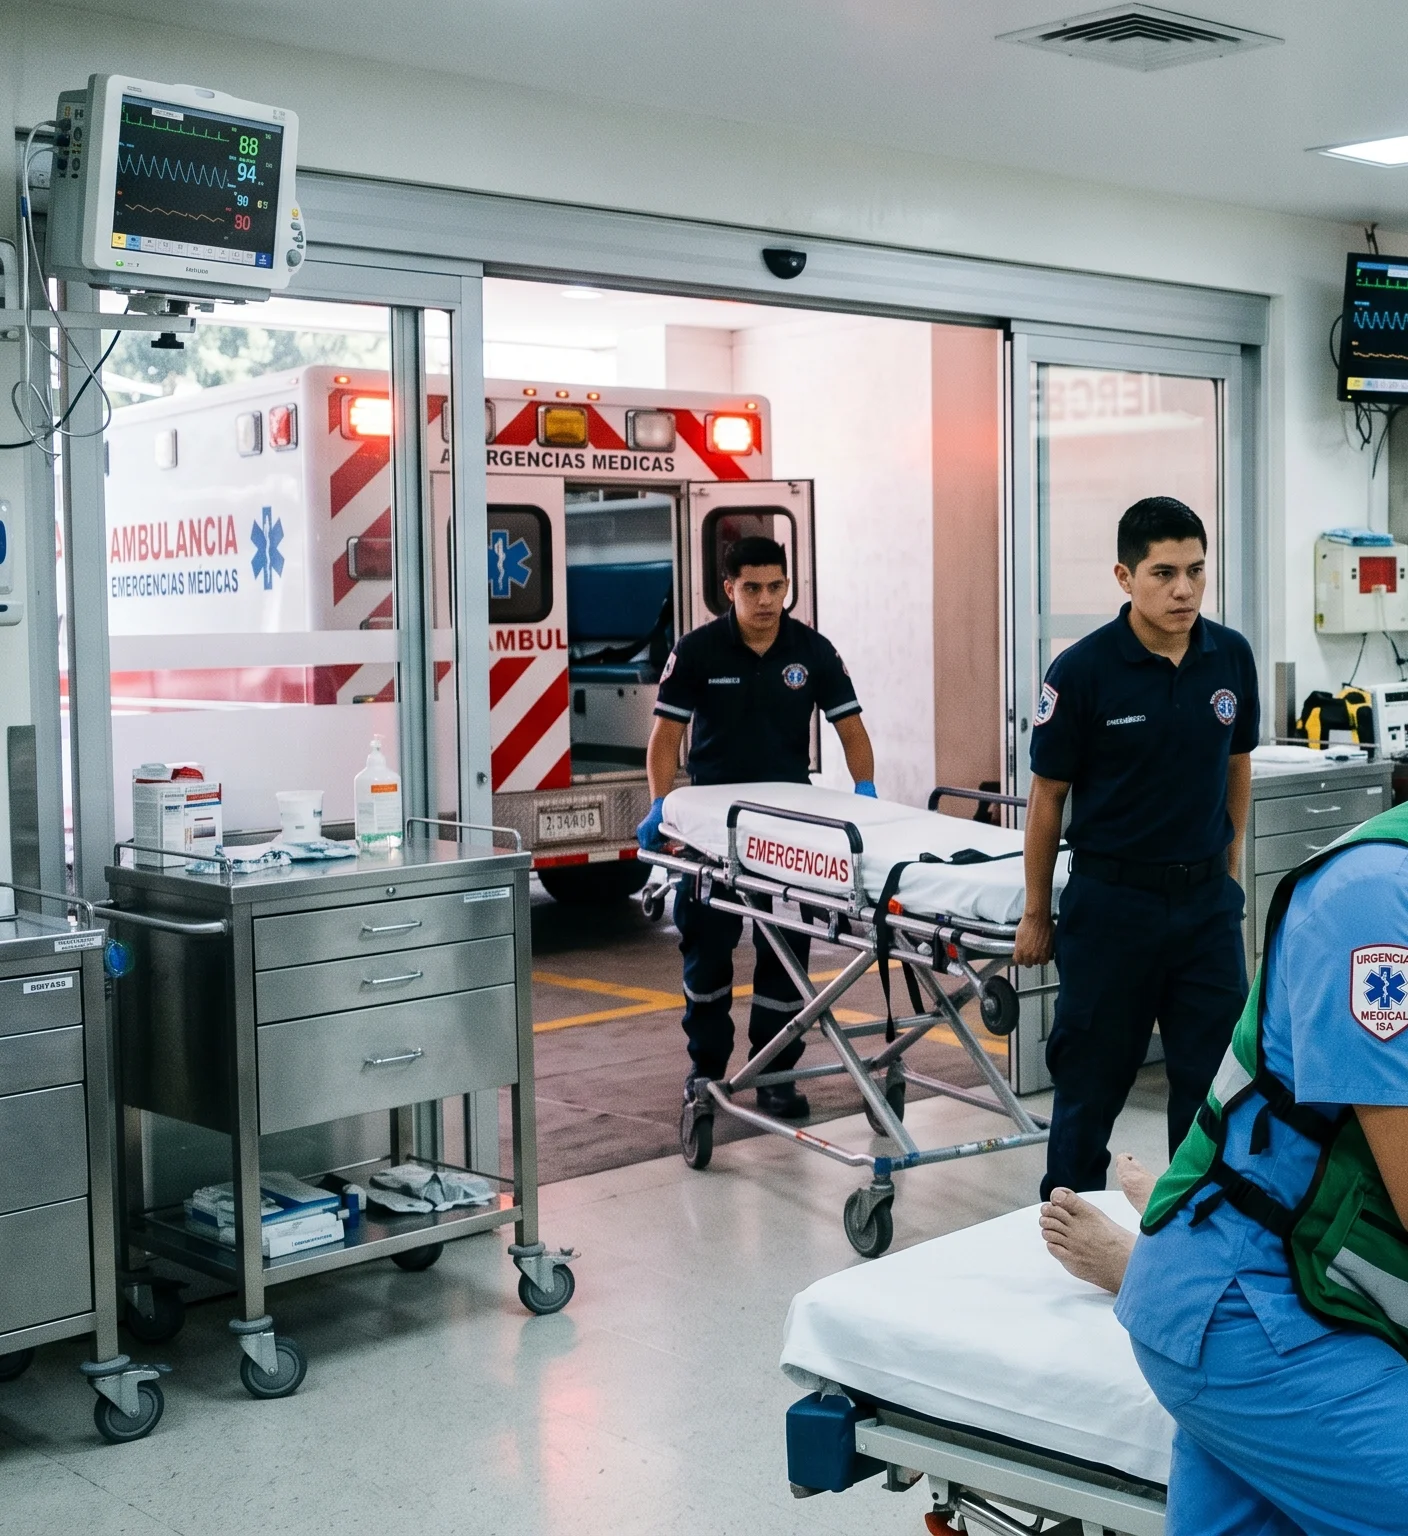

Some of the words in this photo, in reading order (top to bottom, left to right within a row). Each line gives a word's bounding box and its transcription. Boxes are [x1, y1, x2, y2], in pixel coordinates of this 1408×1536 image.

[239, 135, 259, 156] 88
[237, 163, 257, 183] 94
[592, 454, 675, 472] MEDICAS
[110, 514, 238, 564] AMBULANCIA
[111, 575, 185, 598] EMERGENCIAS
[489, 628, 567, 651] MBUL
[746, 836, 849, 882] EMERGENCIAS
